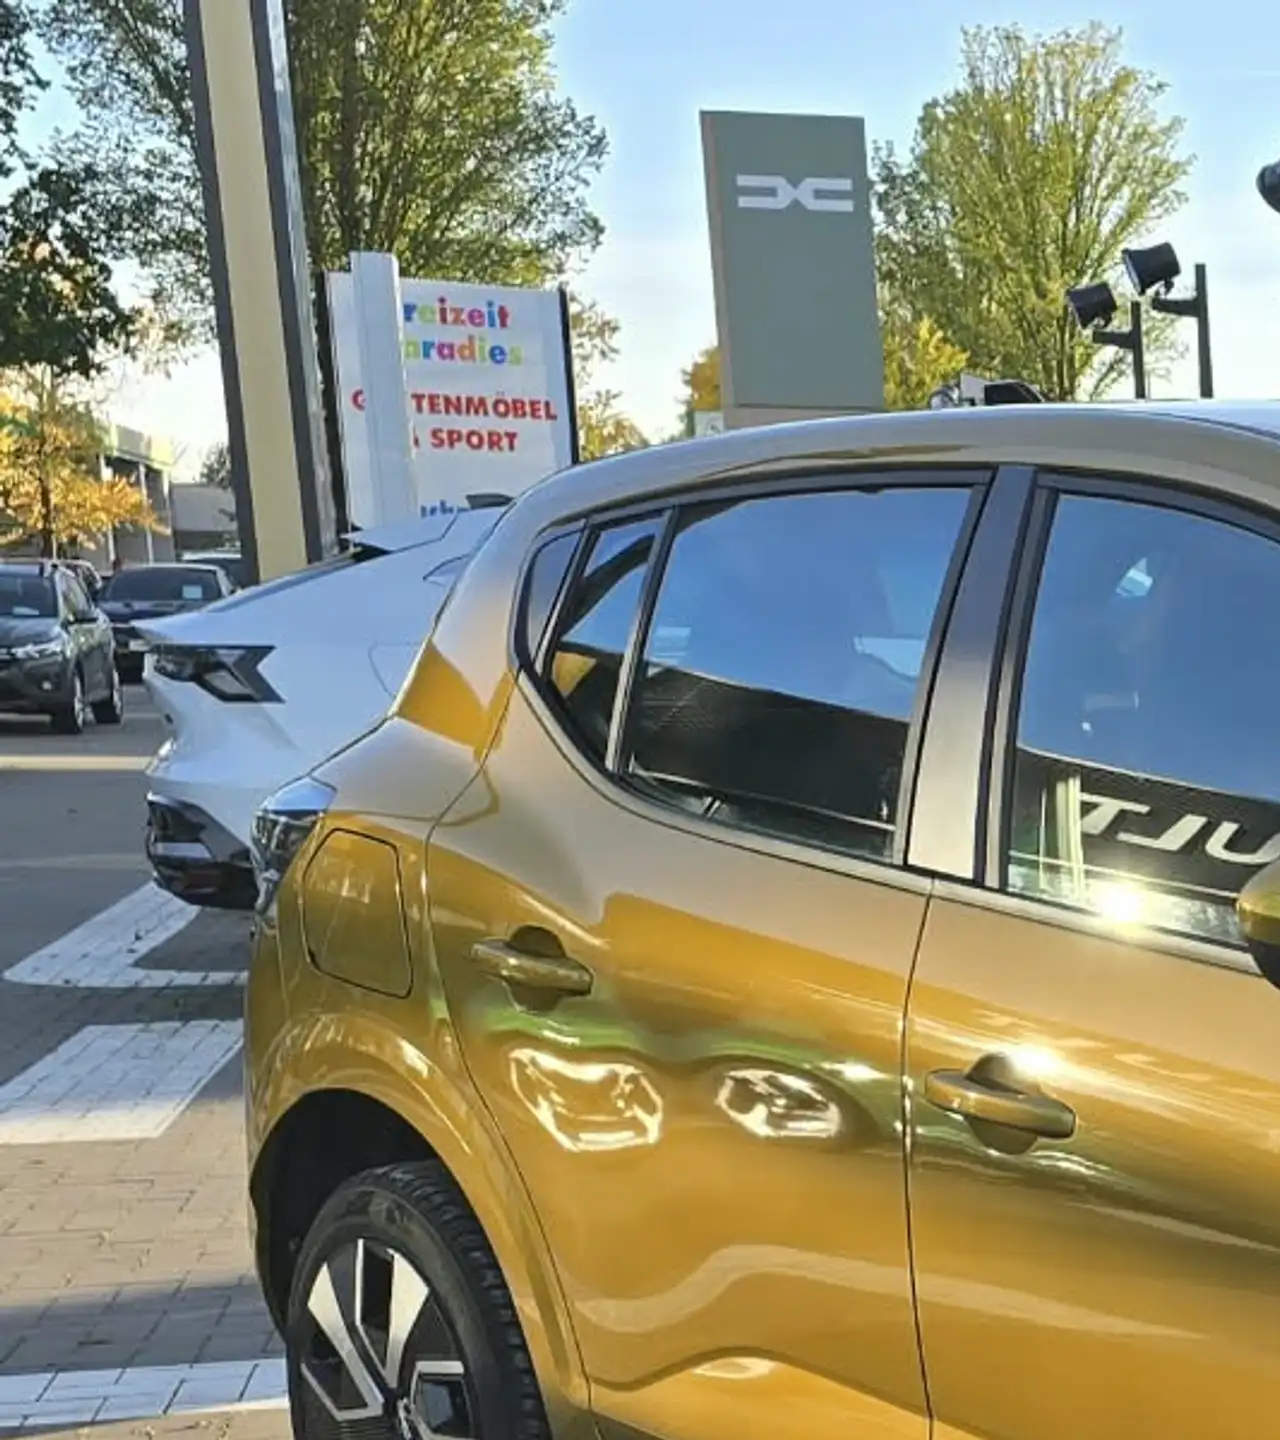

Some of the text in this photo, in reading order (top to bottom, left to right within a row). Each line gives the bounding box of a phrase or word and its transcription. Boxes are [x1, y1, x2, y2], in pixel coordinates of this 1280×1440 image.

[403, 297, 509, 328] reizeit
[404, 336, 522, 365] aradies
[430, 428, 518, 451] SPORT
